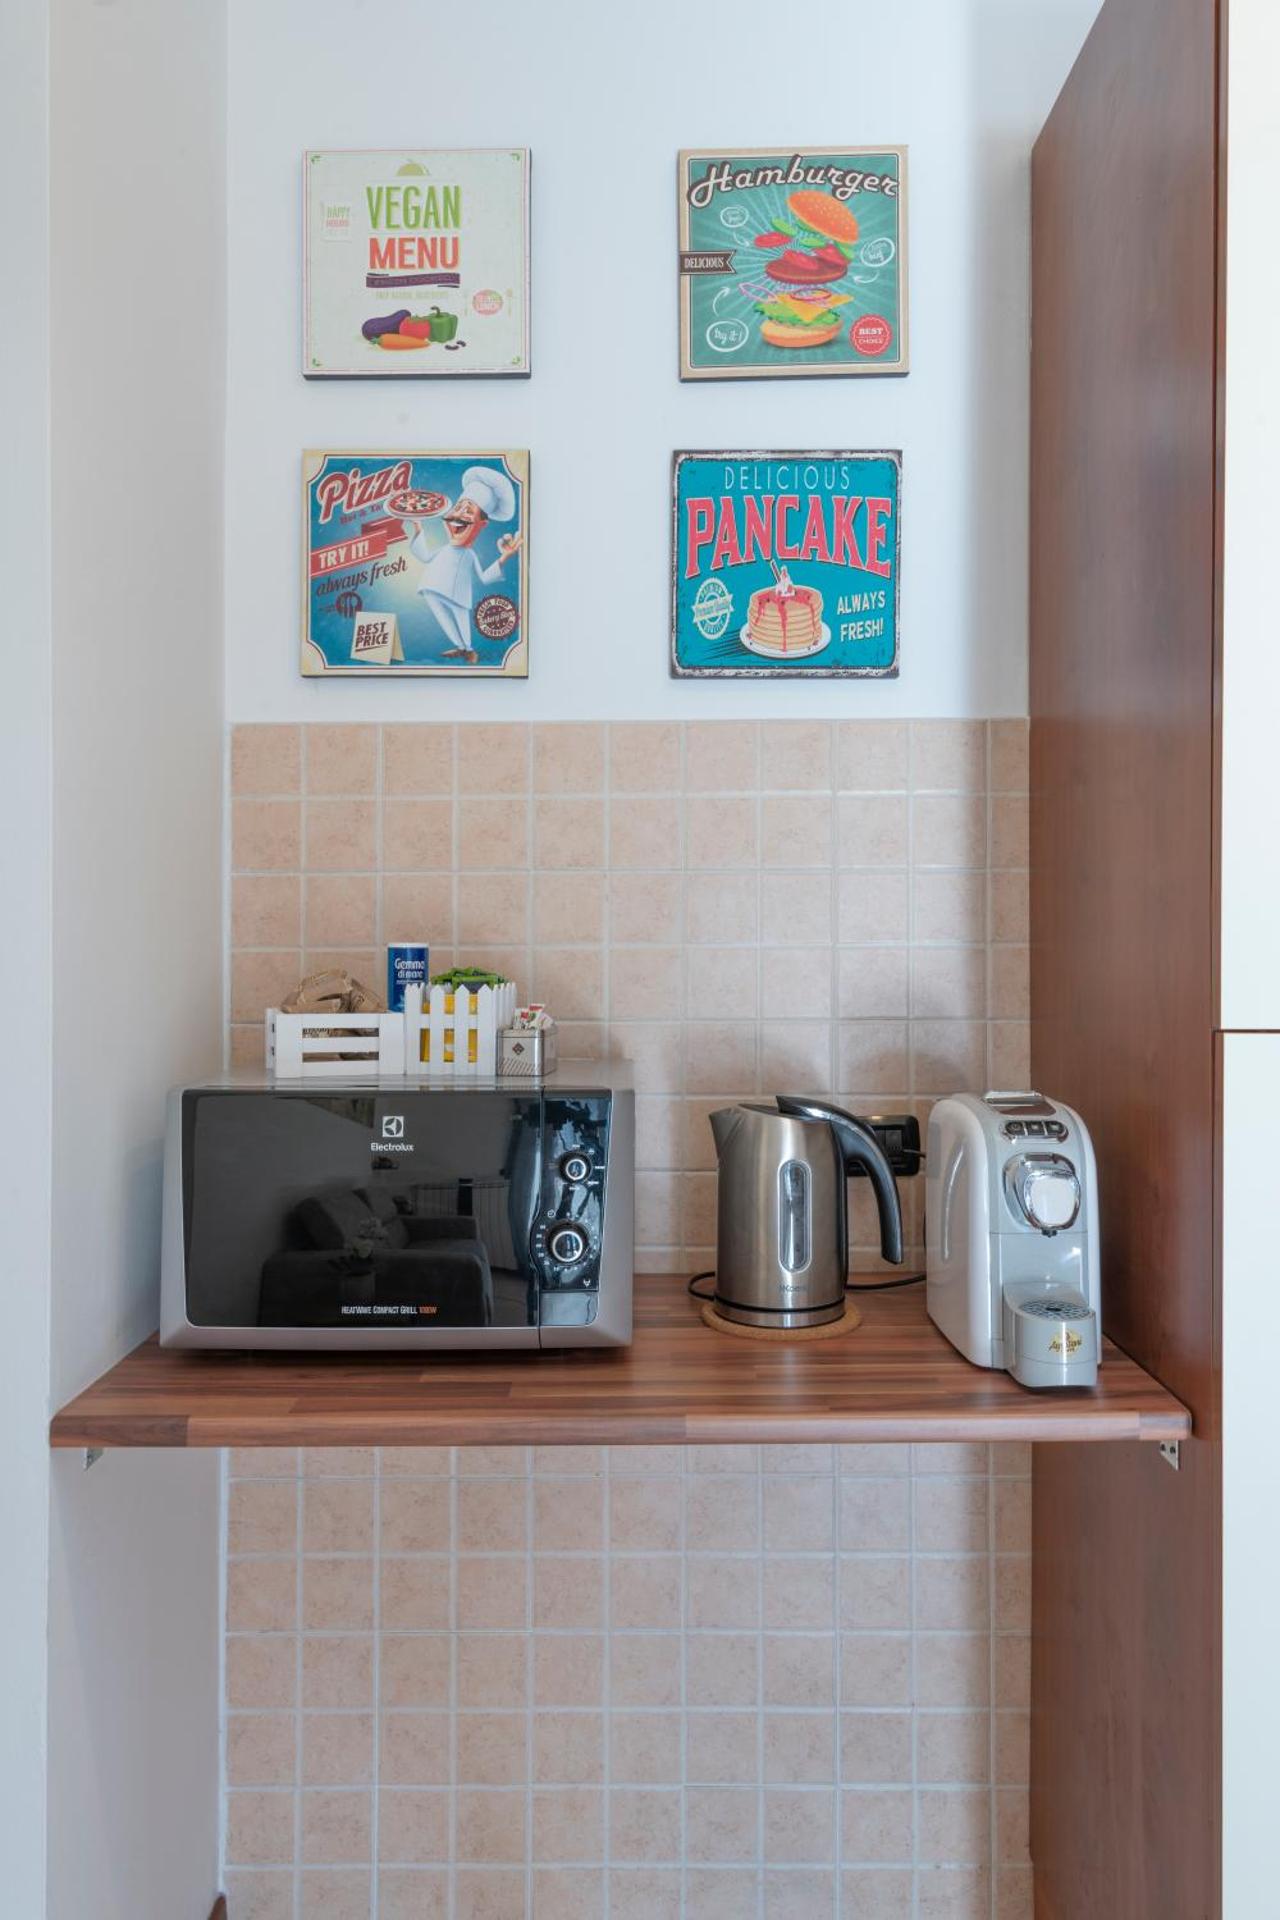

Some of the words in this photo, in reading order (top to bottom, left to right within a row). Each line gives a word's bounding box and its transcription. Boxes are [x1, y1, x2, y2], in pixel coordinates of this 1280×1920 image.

[687, 154, 900, 209] Hamburger
[365, 185, 462, 230] VEGAN
[368, 236, 460, 270] MENU
[684, 256, 724, 269] DELICIOUS
[859, 327, 883, 335] BEST
[724, 465, 851, 490] DELICIOUS
[316, 460, 414, 524] Pizza
[685, 494, 893, 580] PANCAKE
[319, 548, 349, 570] TRY
[350, 540, 370, 561] IT!
[316, 571, 369, 597] always
[369, 556, 408, 586] fresh
[836, 590, 886, 615] ALWAYS
[355, 632, 389, 648] PRICE
[356, 621, 388, 637] BEST
[840, 617, 884, 641] FRESH!
[370, 1142, 415, 1152] Electrolux
[373, 1305, 400, 1314] COMPACT
[400, 1305, 418, 1314] GRILL
